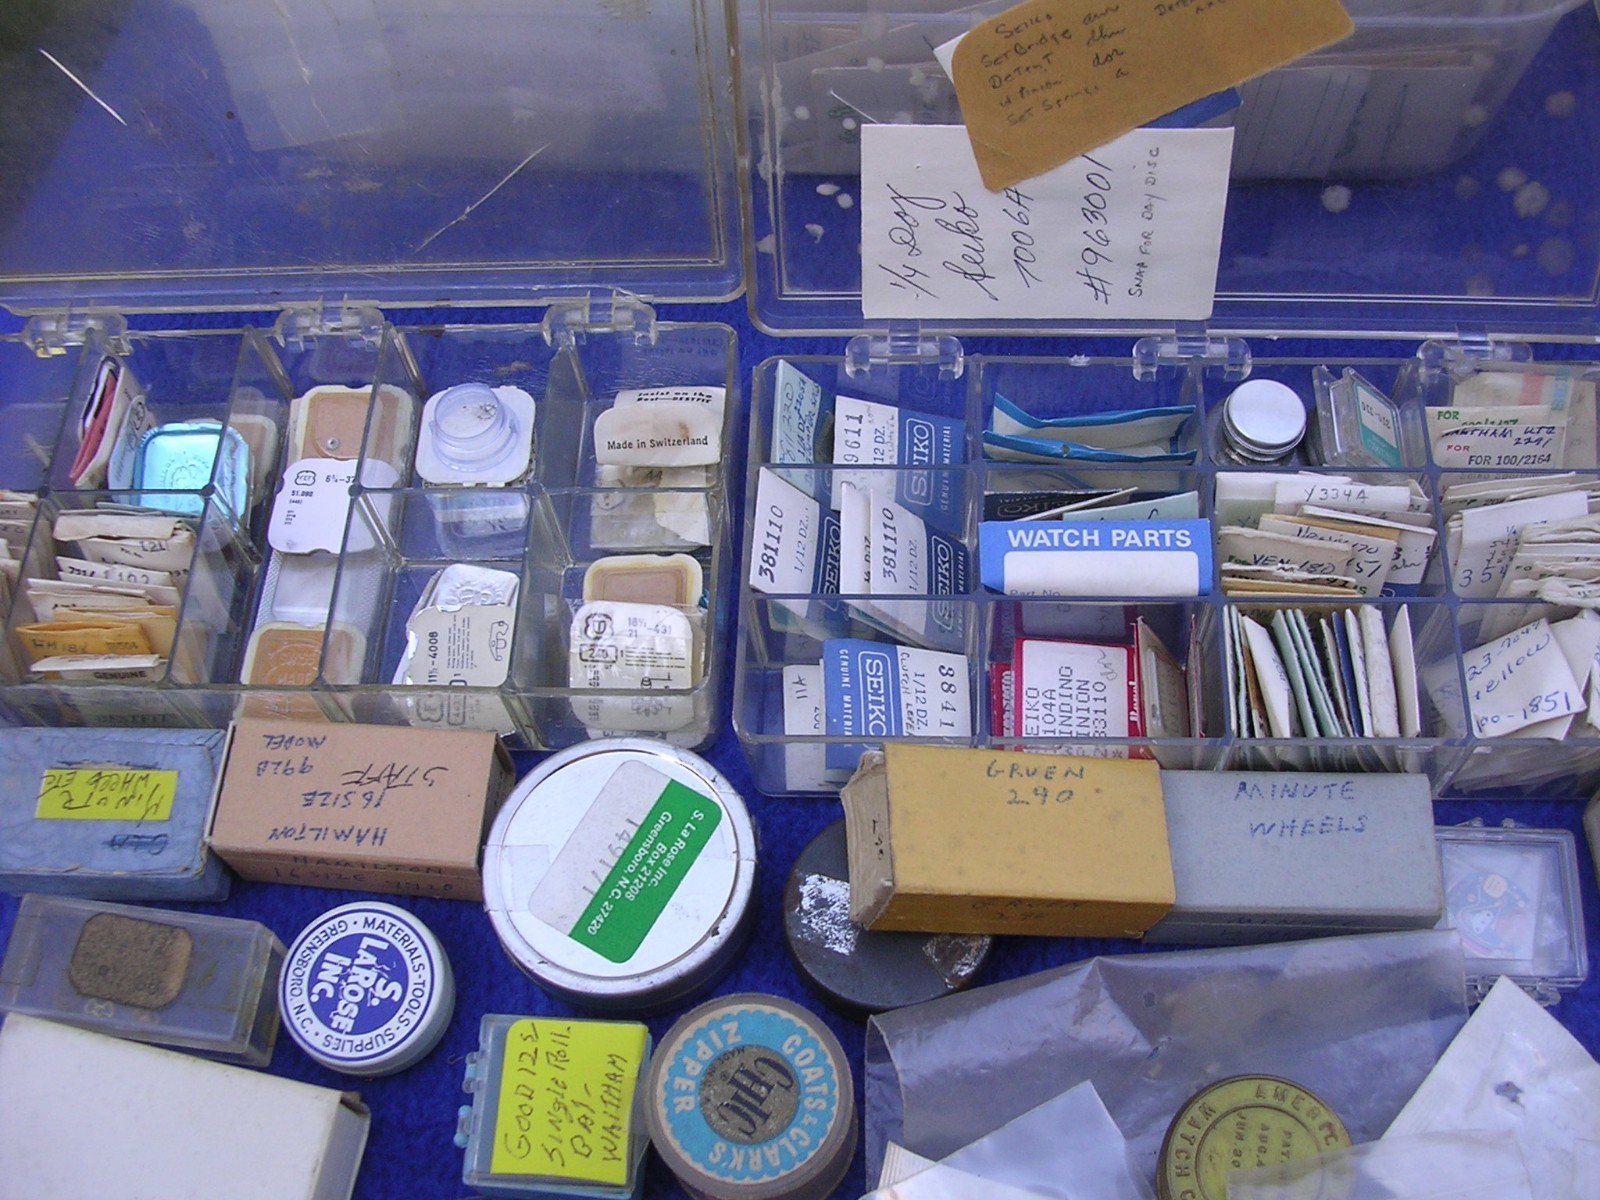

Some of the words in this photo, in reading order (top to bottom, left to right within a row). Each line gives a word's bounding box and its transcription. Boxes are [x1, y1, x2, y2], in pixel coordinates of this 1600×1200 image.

[1077, 154, 1112, 304] #963001
[1437, 411, 1459, 420] FOR
[607, 440, 633, 450] Made
[637, 439, 646, 449] in
[649, 435, 709, 448] Switzerland
[1468, 455, 1491, 465] FOR
[1496, 453, 1552, 465] 100/2164
[758, 505, 784, 583] 381110
[882, 508, 897, 582] 381110
[1007, 529, 1100, 547] WATCH
[1111, 529, 1192, 547] PARTS
[94, 670, 147, 678] GENUINE
[840, 649, 850, 687] GENUINE
[866, 659, 887, 738] SEIKO
[914, 672, 926, 705] 1/12
[1058, 666, 1073, 737] INDING
[916, 707, 928, 730] DZ.
[1025, 687, 1040, 736] EIKO
[1042, 688, 1056, 735] 104A
[1075, 679, 1090, 737] INION
[1092, 681, 1107, 737] 83110
[263, 734, 327, 750] MODEL
[986, 759, 1085, 781] GRUEN
[1233, 780, 1356, 802] MINUTE
[680, 822, 697, 838] La
[690, 809, 705, 821] S.
[1250, 815, 1368, 838] WHEELS
[268, 823, 388, 847] HAMILTON
[624, 810, 673, 874] Greensboro,
[650, 842, 668, 867] Box
[664, 838, 687, 867] Rose
[608, 876, 630, 900] N.C.
[625, 865, 651, 901] 21208
[647, 866, 668, 887] Inc.
[587, 901, 613, 936] 27420
[310, 952, 352, 1004] INC.
[371, 977, 404, 1007] S.
[673, 1021, 742, 1114] ZIPPER
[782, 1034, 829, 1111] COATS
[504, 1084, 535, 1160] GOOD
[801, 1114, 818, 1126] &
[1255, 1084, 1339, 1146] AMERIC
[708, 1128, 811, 1171] CLARK'S
[1175, 1102, 1216, 1177] WATCH
